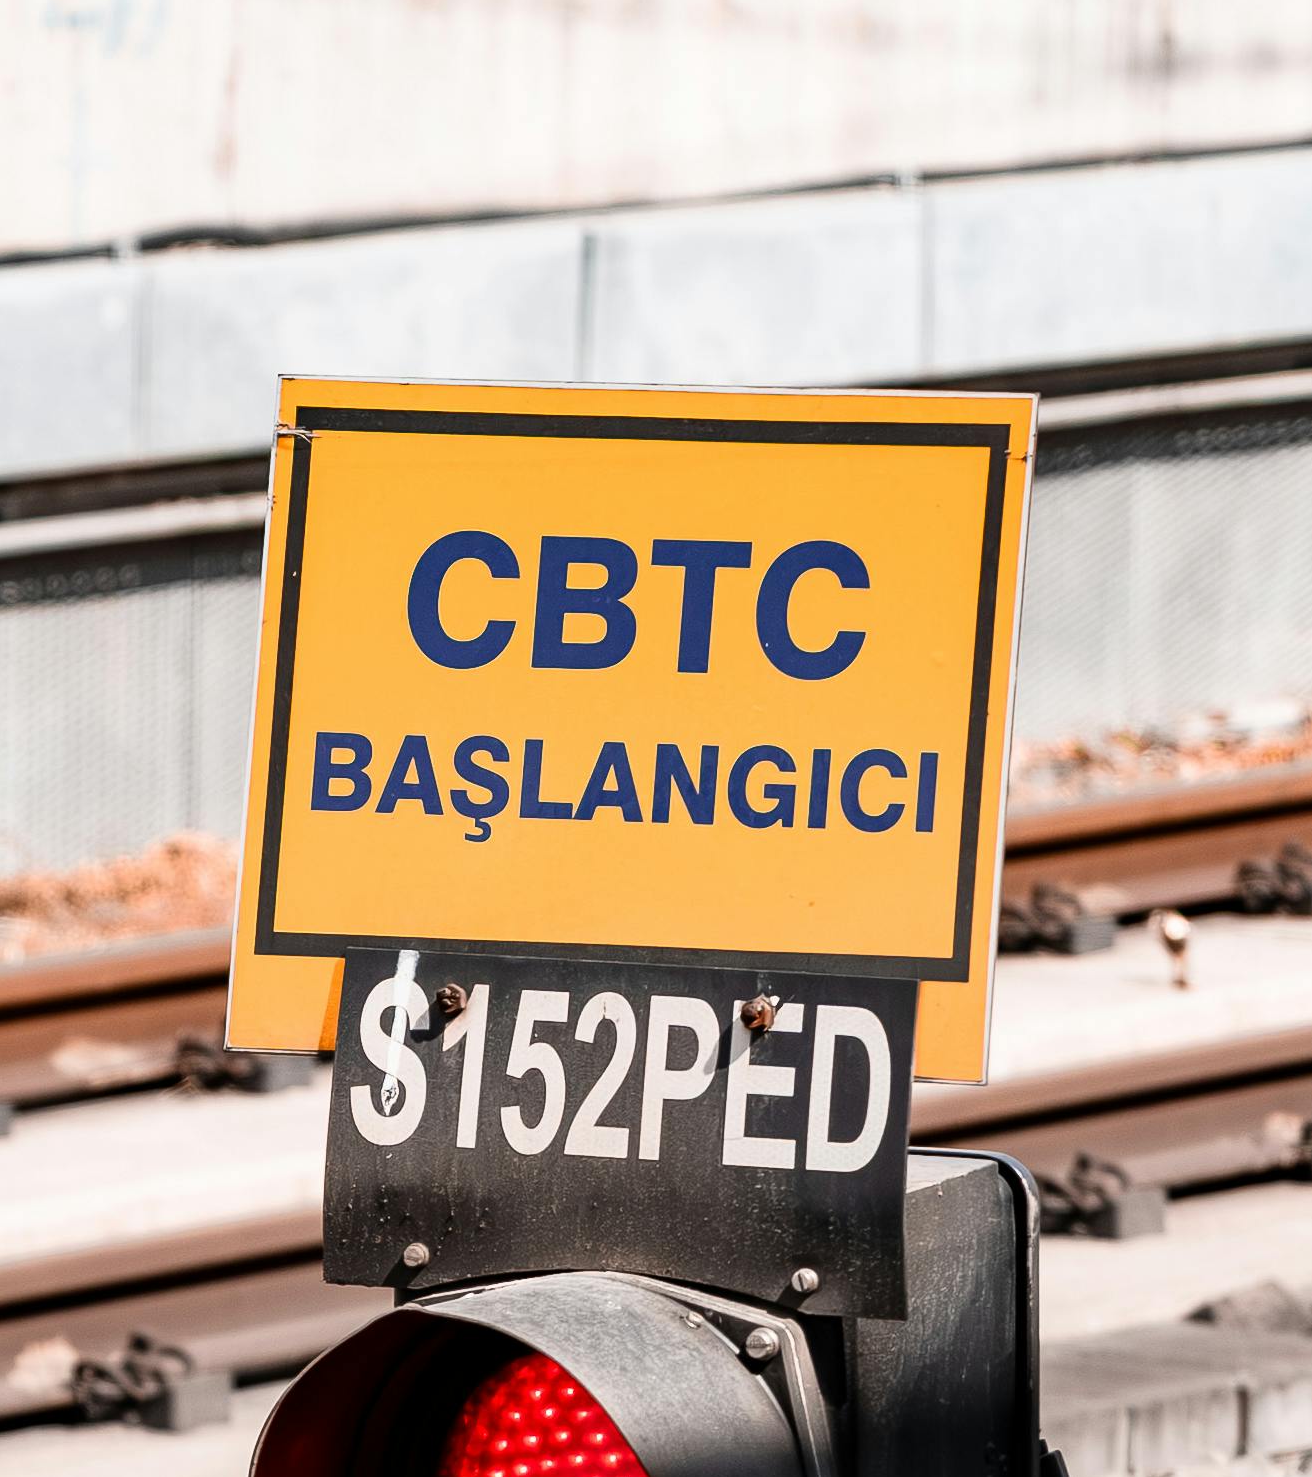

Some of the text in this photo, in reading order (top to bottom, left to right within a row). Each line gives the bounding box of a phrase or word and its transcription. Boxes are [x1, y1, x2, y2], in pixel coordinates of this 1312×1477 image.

[406, 529, 871, 681] CBTC
[310, 731, 939, 843] BAŞLANGICI
[349, 977, 893, 1174] S152PED
